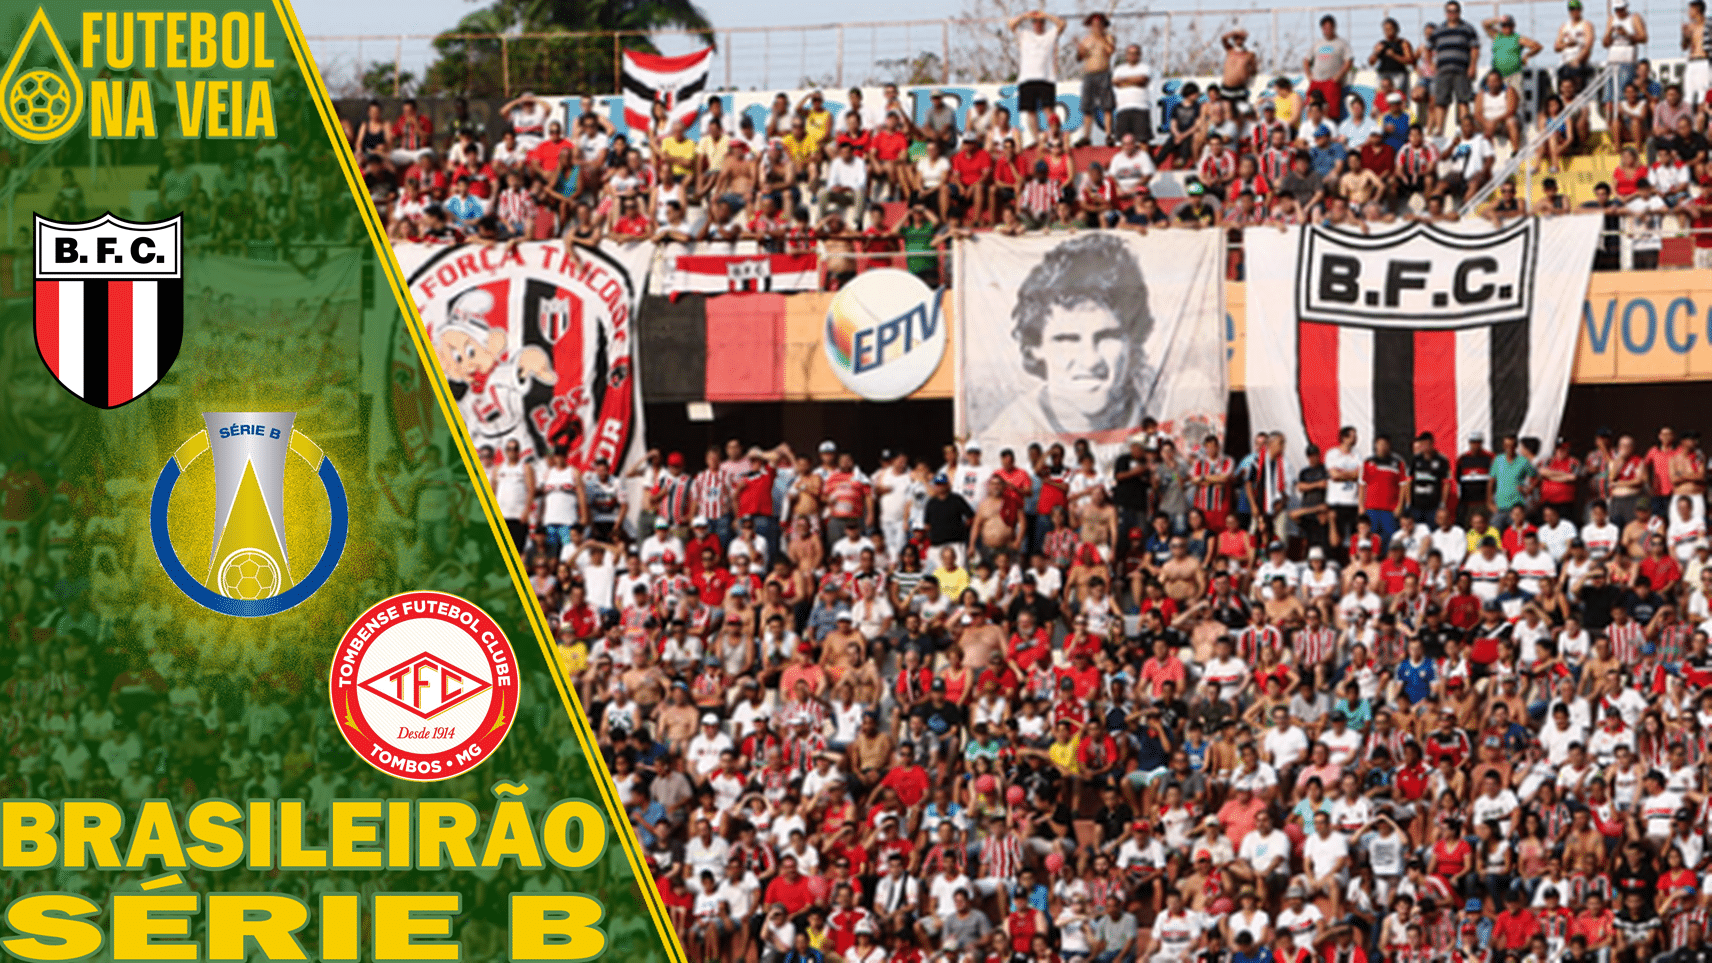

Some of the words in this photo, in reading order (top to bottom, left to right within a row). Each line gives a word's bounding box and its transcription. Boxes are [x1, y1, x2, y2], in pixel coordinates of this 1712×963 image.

[1318, 253, 1513, 309] B.F.C.
[853, 284, 946, 376] EPTV
[1584, 296, 1712, 355] VOC
